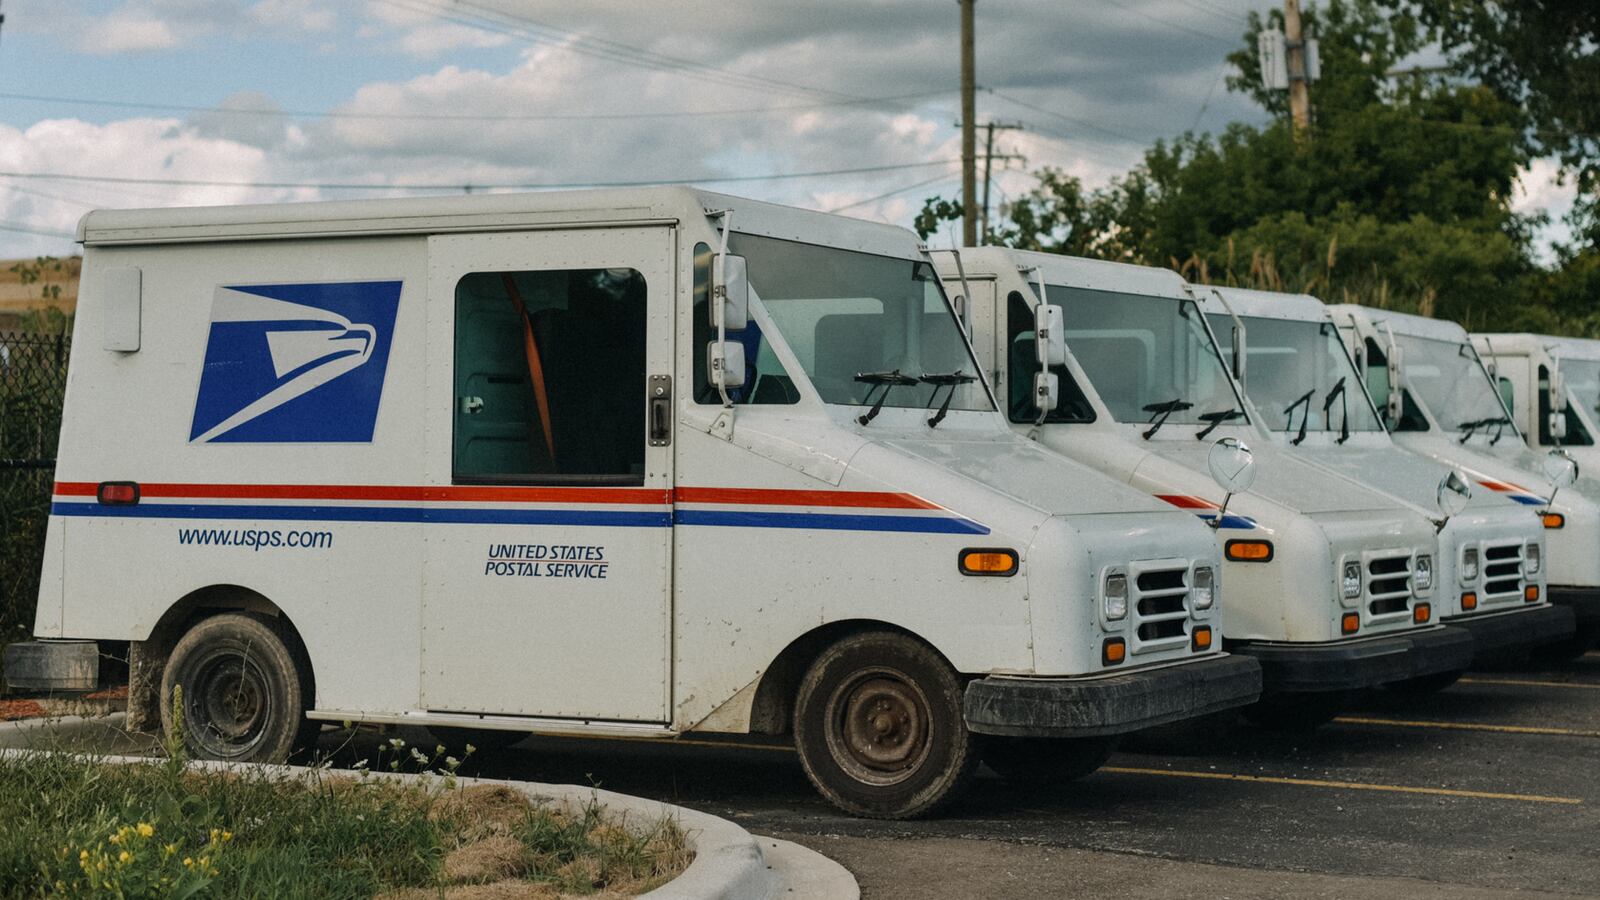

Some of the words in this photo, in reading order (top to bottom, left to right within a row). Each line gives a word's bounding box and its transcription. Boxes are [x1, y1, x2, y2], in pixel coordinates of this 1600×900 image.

[178, 528, 333, 551] www.usps.com
[488, 544, 547, 559] UNITED
[549, 545, 605, 561] STATES
[485, 561, 541, 577] POSTAL
[545, 563, 609, 579] SERVICE
